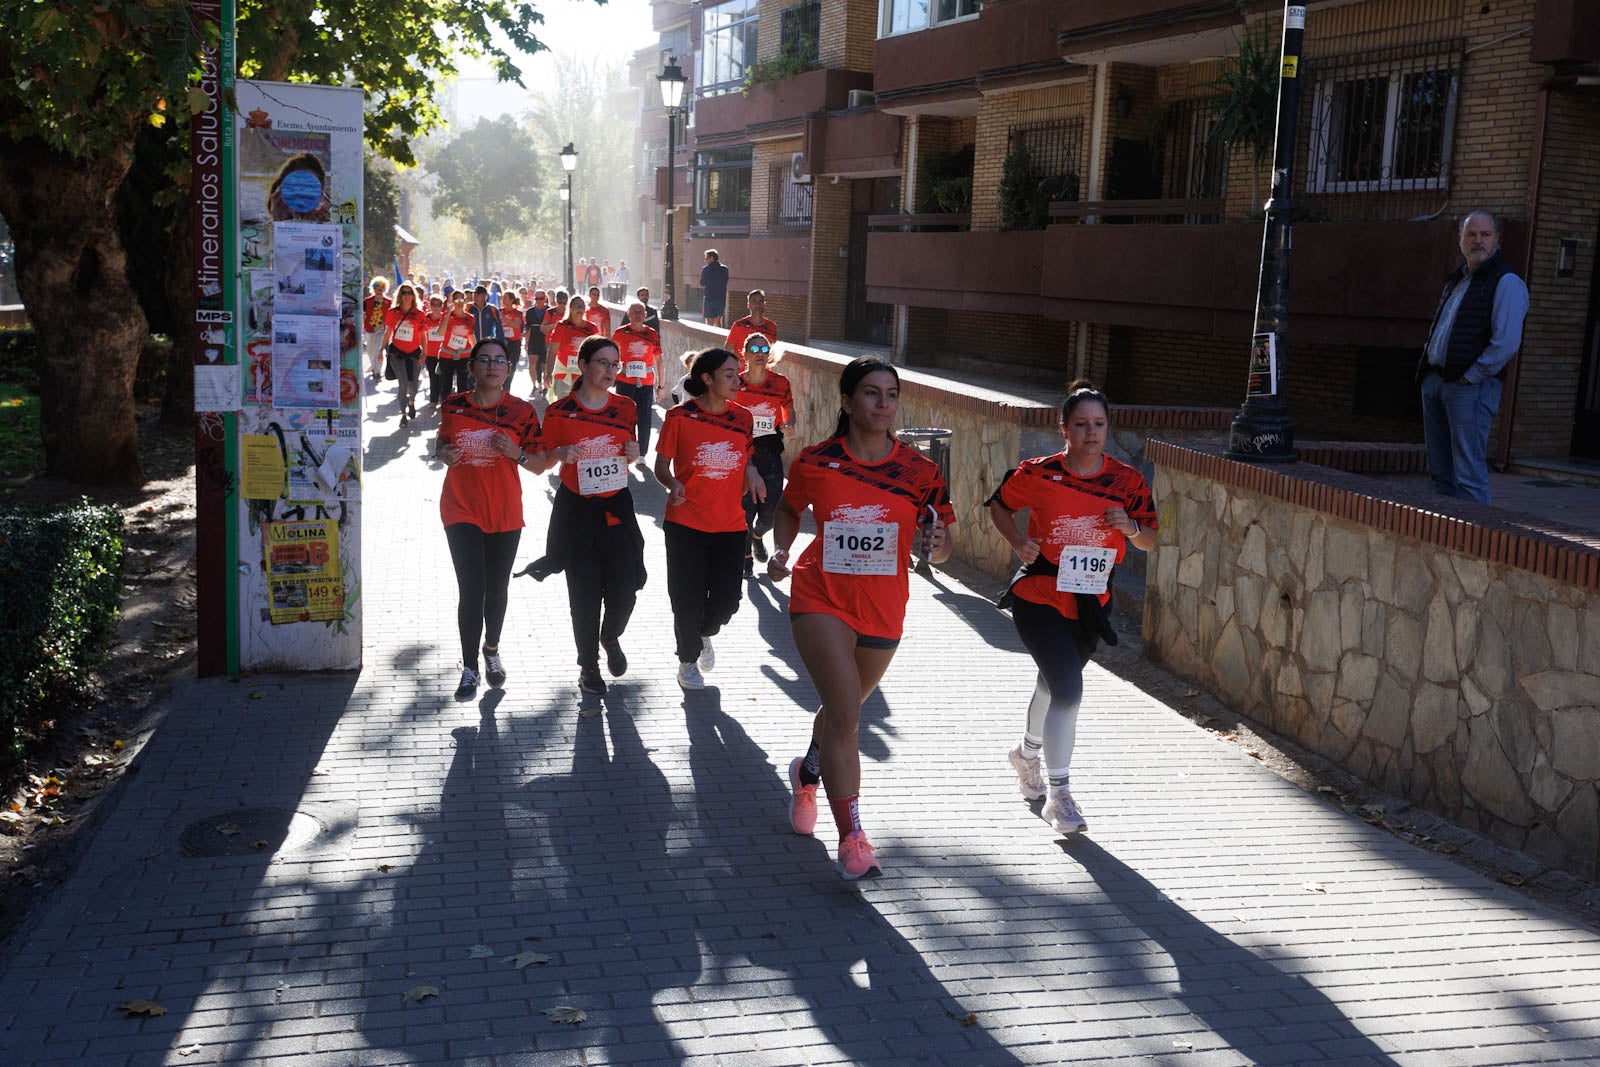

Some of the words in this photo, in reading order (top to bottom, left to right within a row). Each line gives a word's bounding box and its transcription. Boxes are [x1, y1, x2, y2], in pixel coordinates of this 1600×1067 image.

[304, 122, 357, 133] Ayuntamiento
[197, 312, 232, 321] MPS
[697, 450, 739, 461] carrera
[585, 463, 619, 478] 1033
[1053, 525, 1106, 541] carrera
[835, 534, 885, 551] 1062
[1069, 555, 1106, 572] 1196
[308, 586, 328, 598] 149
[333, 585, 341, 596] €
